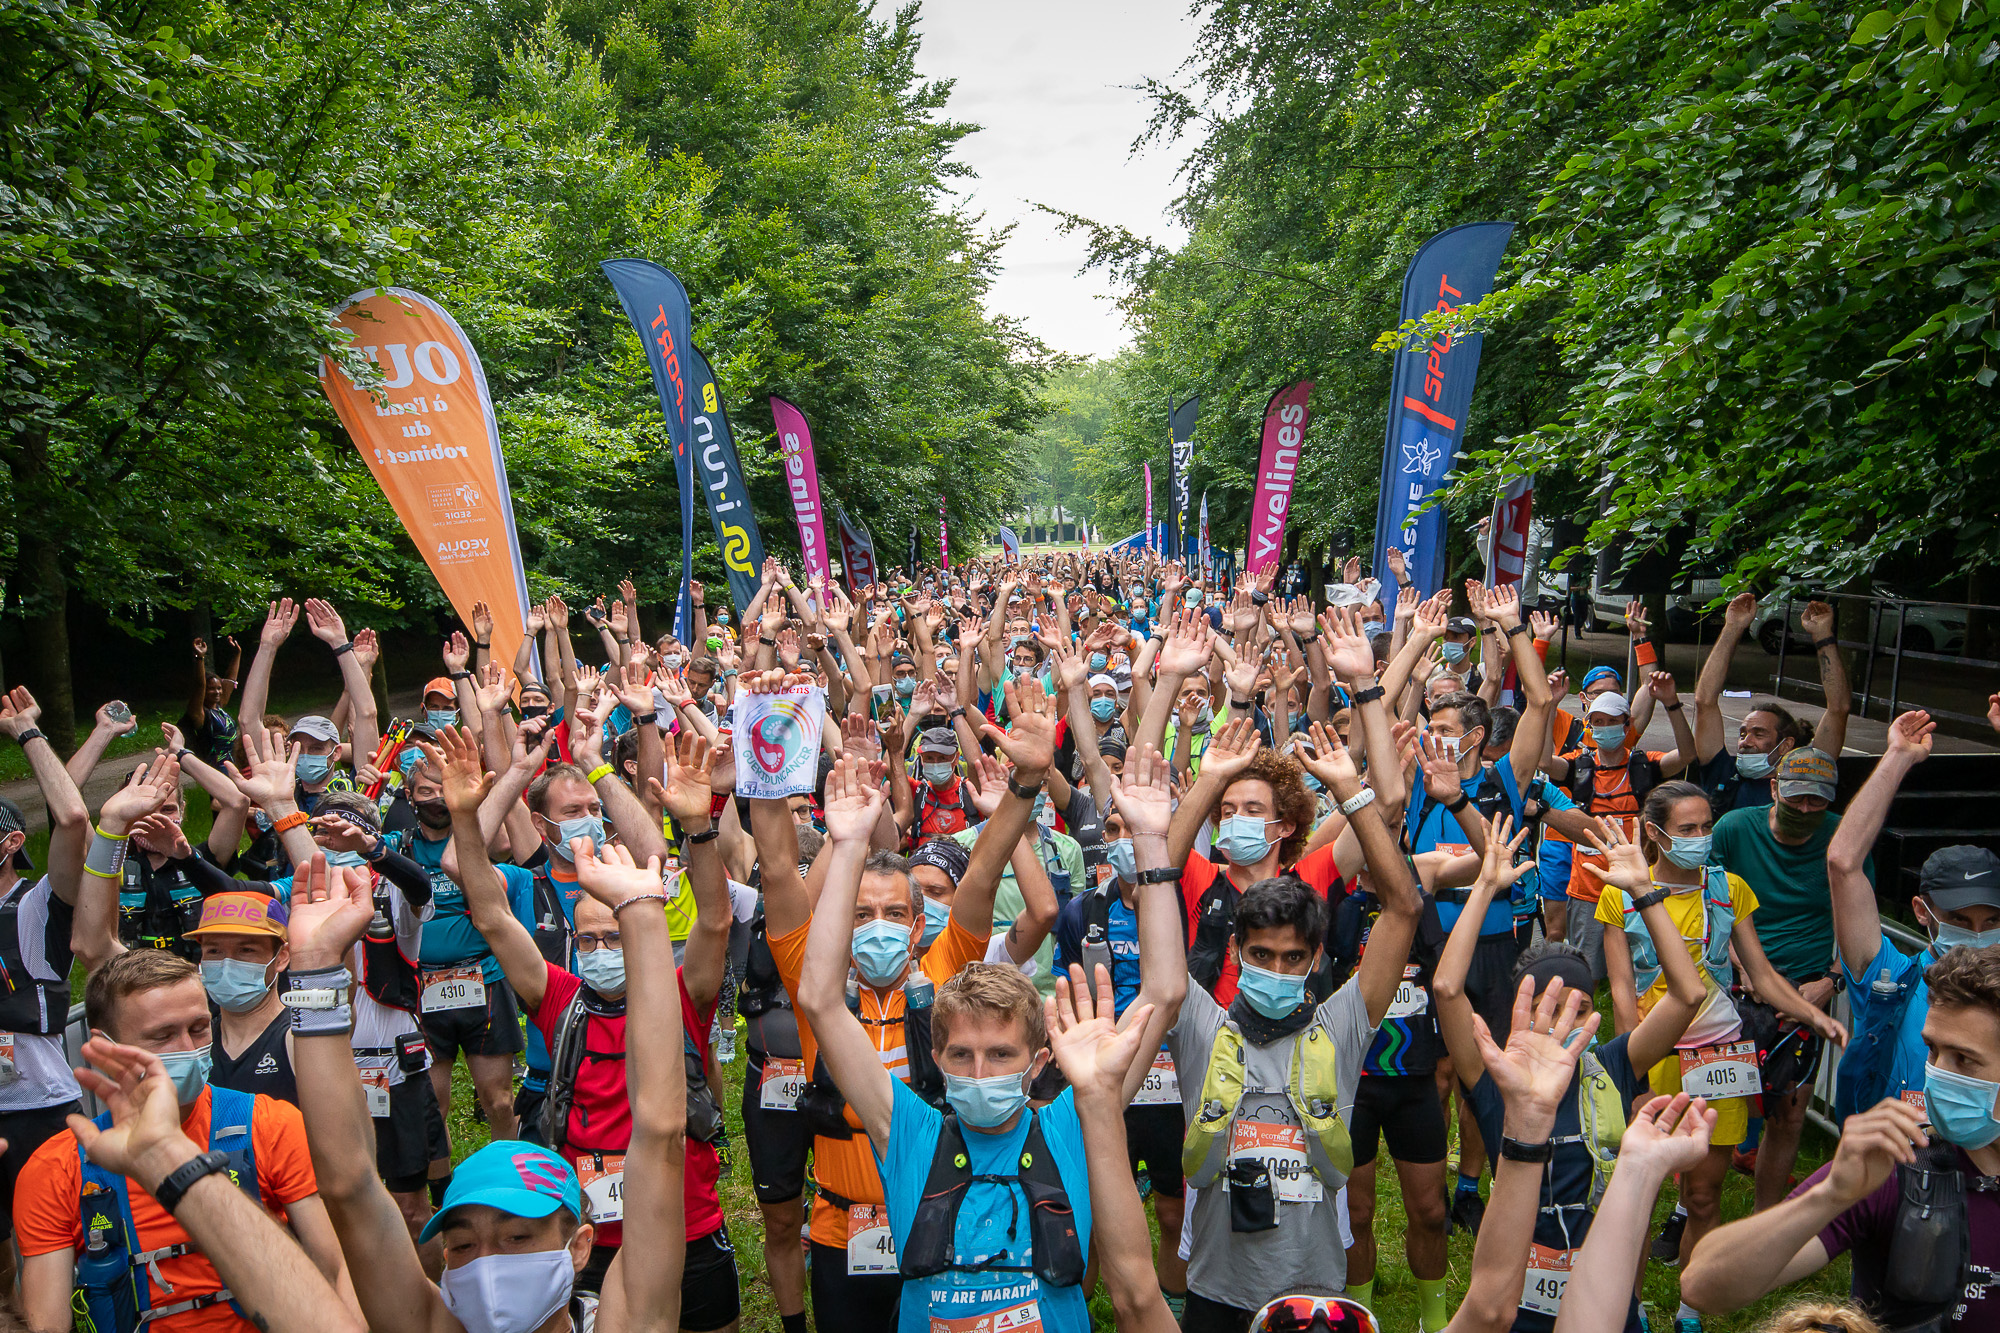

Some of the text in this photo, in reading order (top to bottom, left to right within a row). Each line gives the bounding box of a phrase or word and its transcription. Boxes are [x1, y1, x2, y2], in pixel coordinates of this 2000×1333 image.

[1255, 404, 1304, 559] Yvelines
[203, 901, 262, 922] ciele
[440, 984, 466, 999] 4310
[1706, 1067, 1737, 1086] 4015
[1235, 1128, 1257, 1139] 5KM
[931, 1290, 947, 1303] WE
[951, 1291, 976, 1304] ARE
